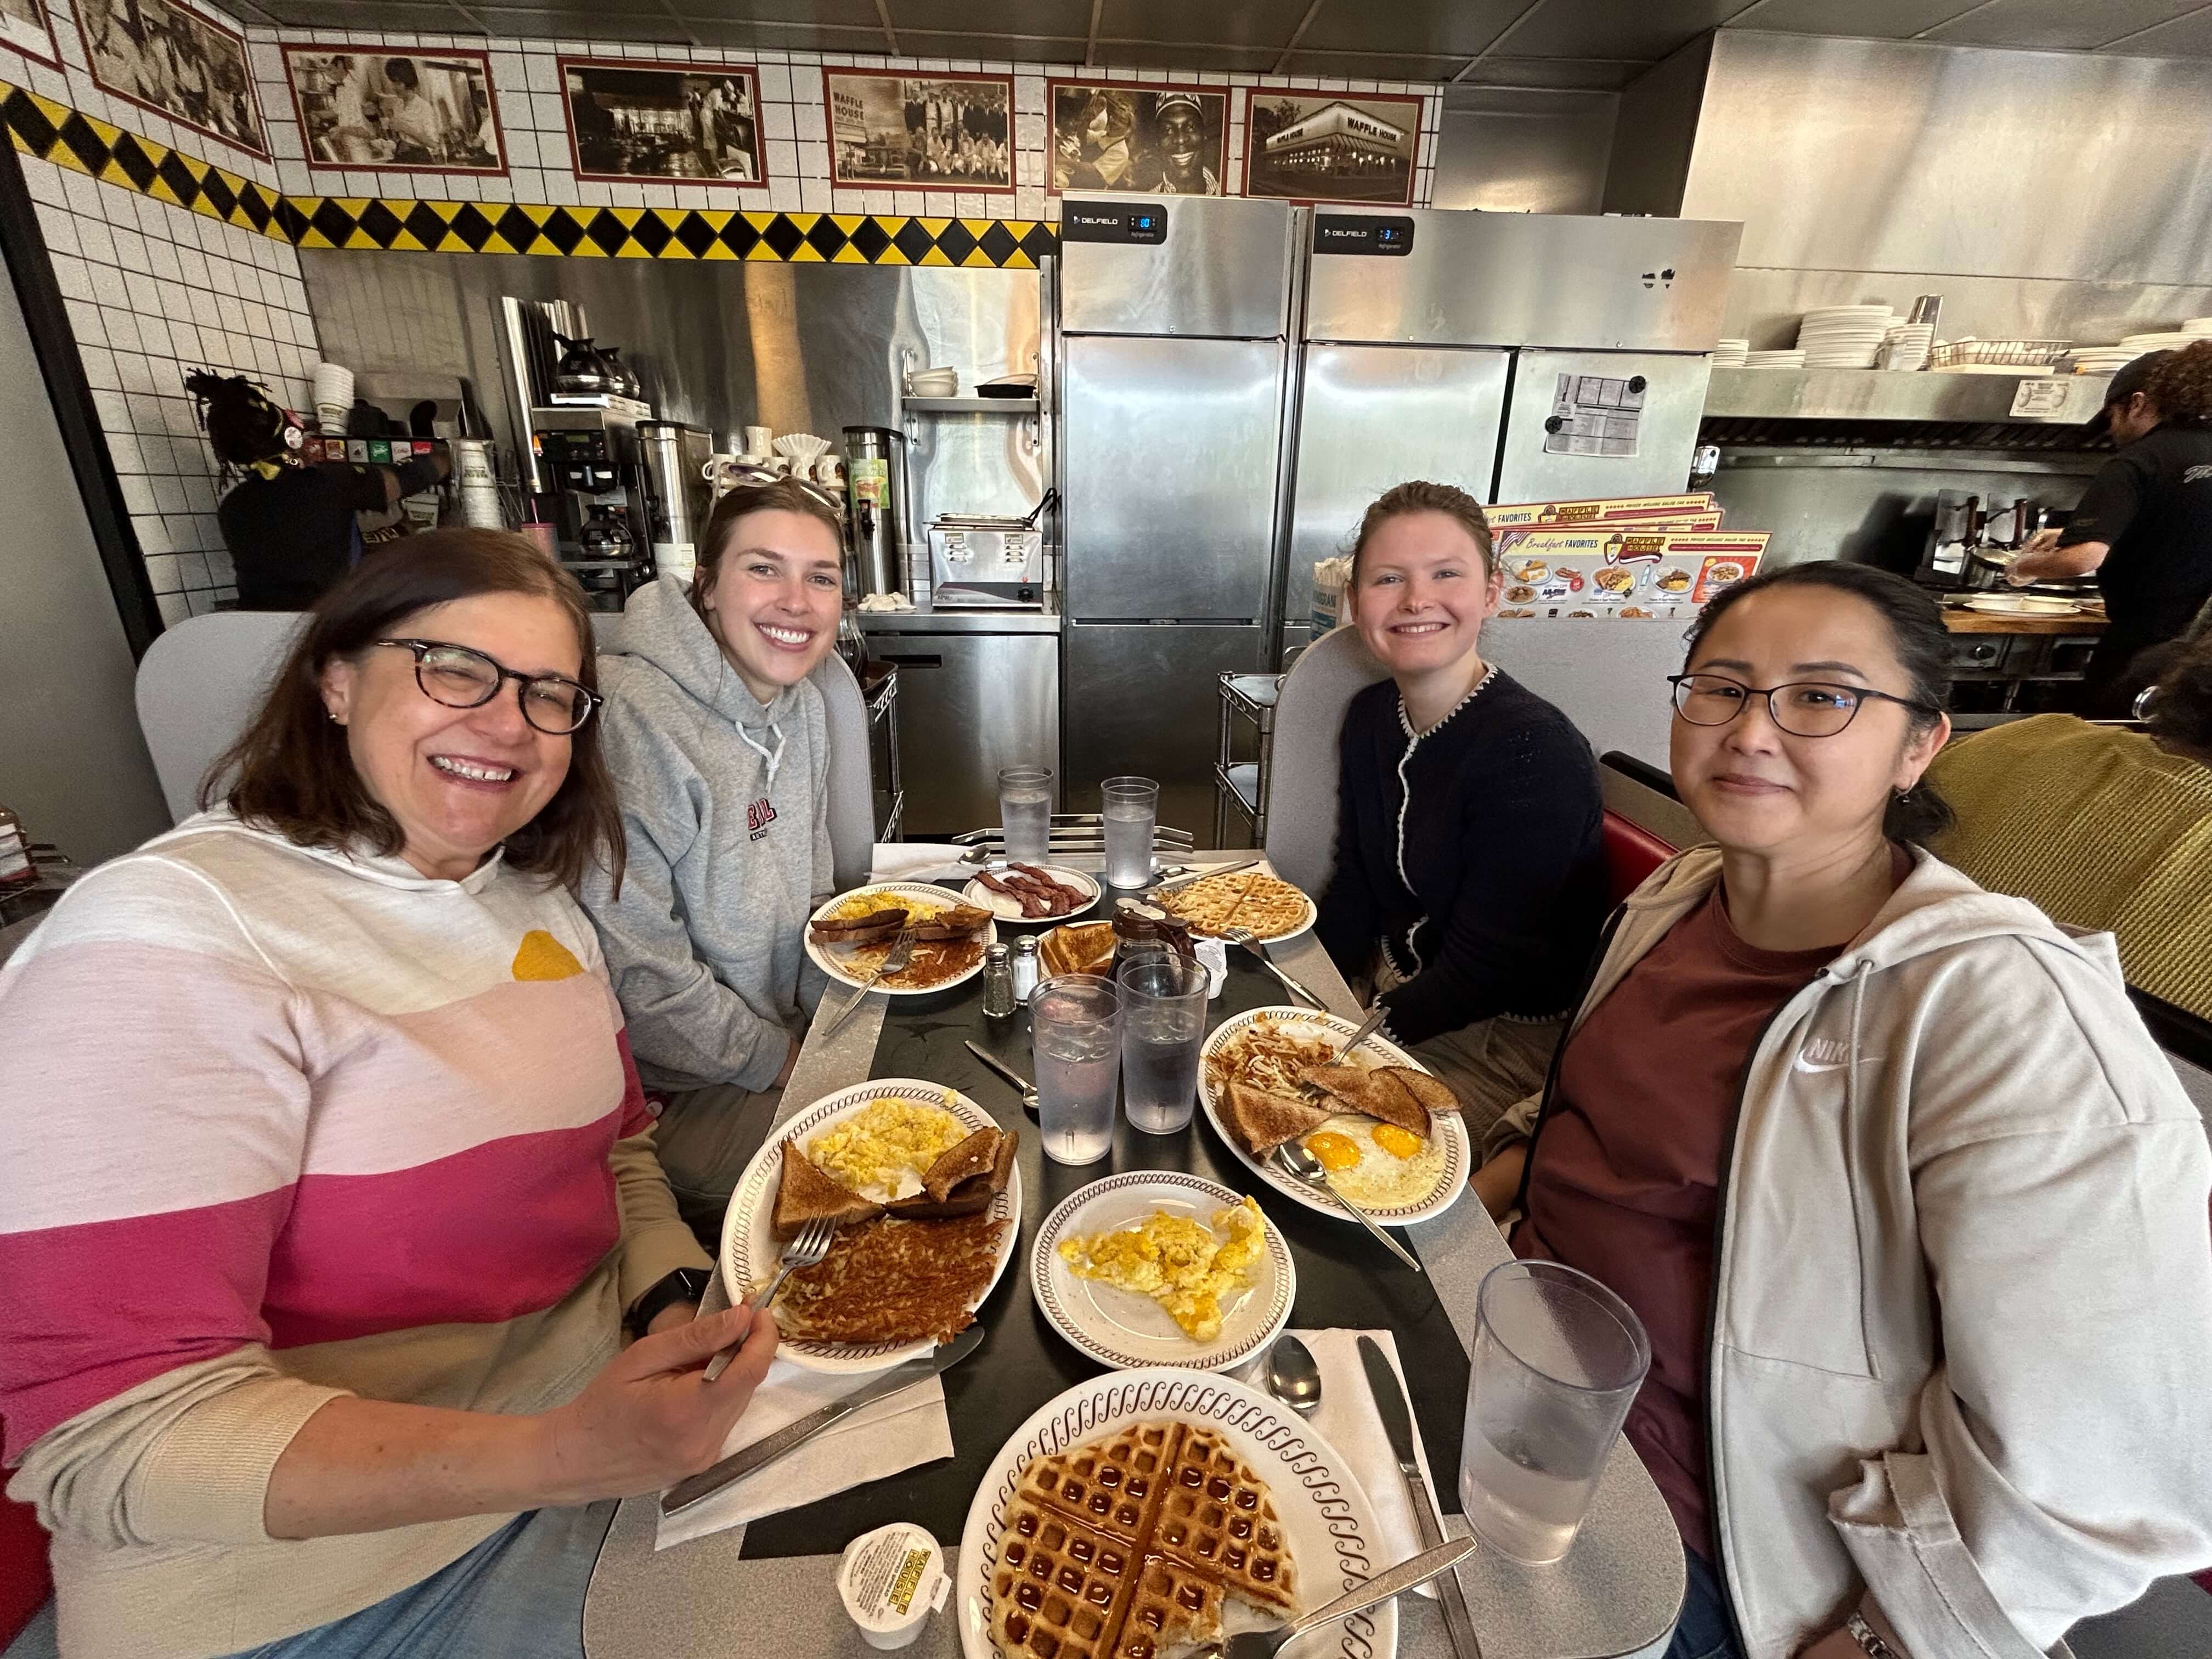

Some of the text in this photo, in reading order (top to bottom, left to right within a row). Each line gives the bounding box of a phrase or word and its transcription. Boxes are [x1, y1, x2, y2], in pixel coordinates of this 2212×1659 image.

[833, 92, 863, 109] WAFFLE
[835, 105, 865, 121] HOUSE
[1347, 117, 1396, 142] WAFFLE HOUSE
[1081, 217, 1118, 225] DELFIELD
[1498, 512, 1532, 523] FAVORITES
[1526, 538, 1598, 552] Breakfast FAVORITES
[1626, 537, 1666, 545] WAFFLE
[888, 1549, 919, 1605] HOUSE
[895, 1548, 932, 1616] WAFFLE
